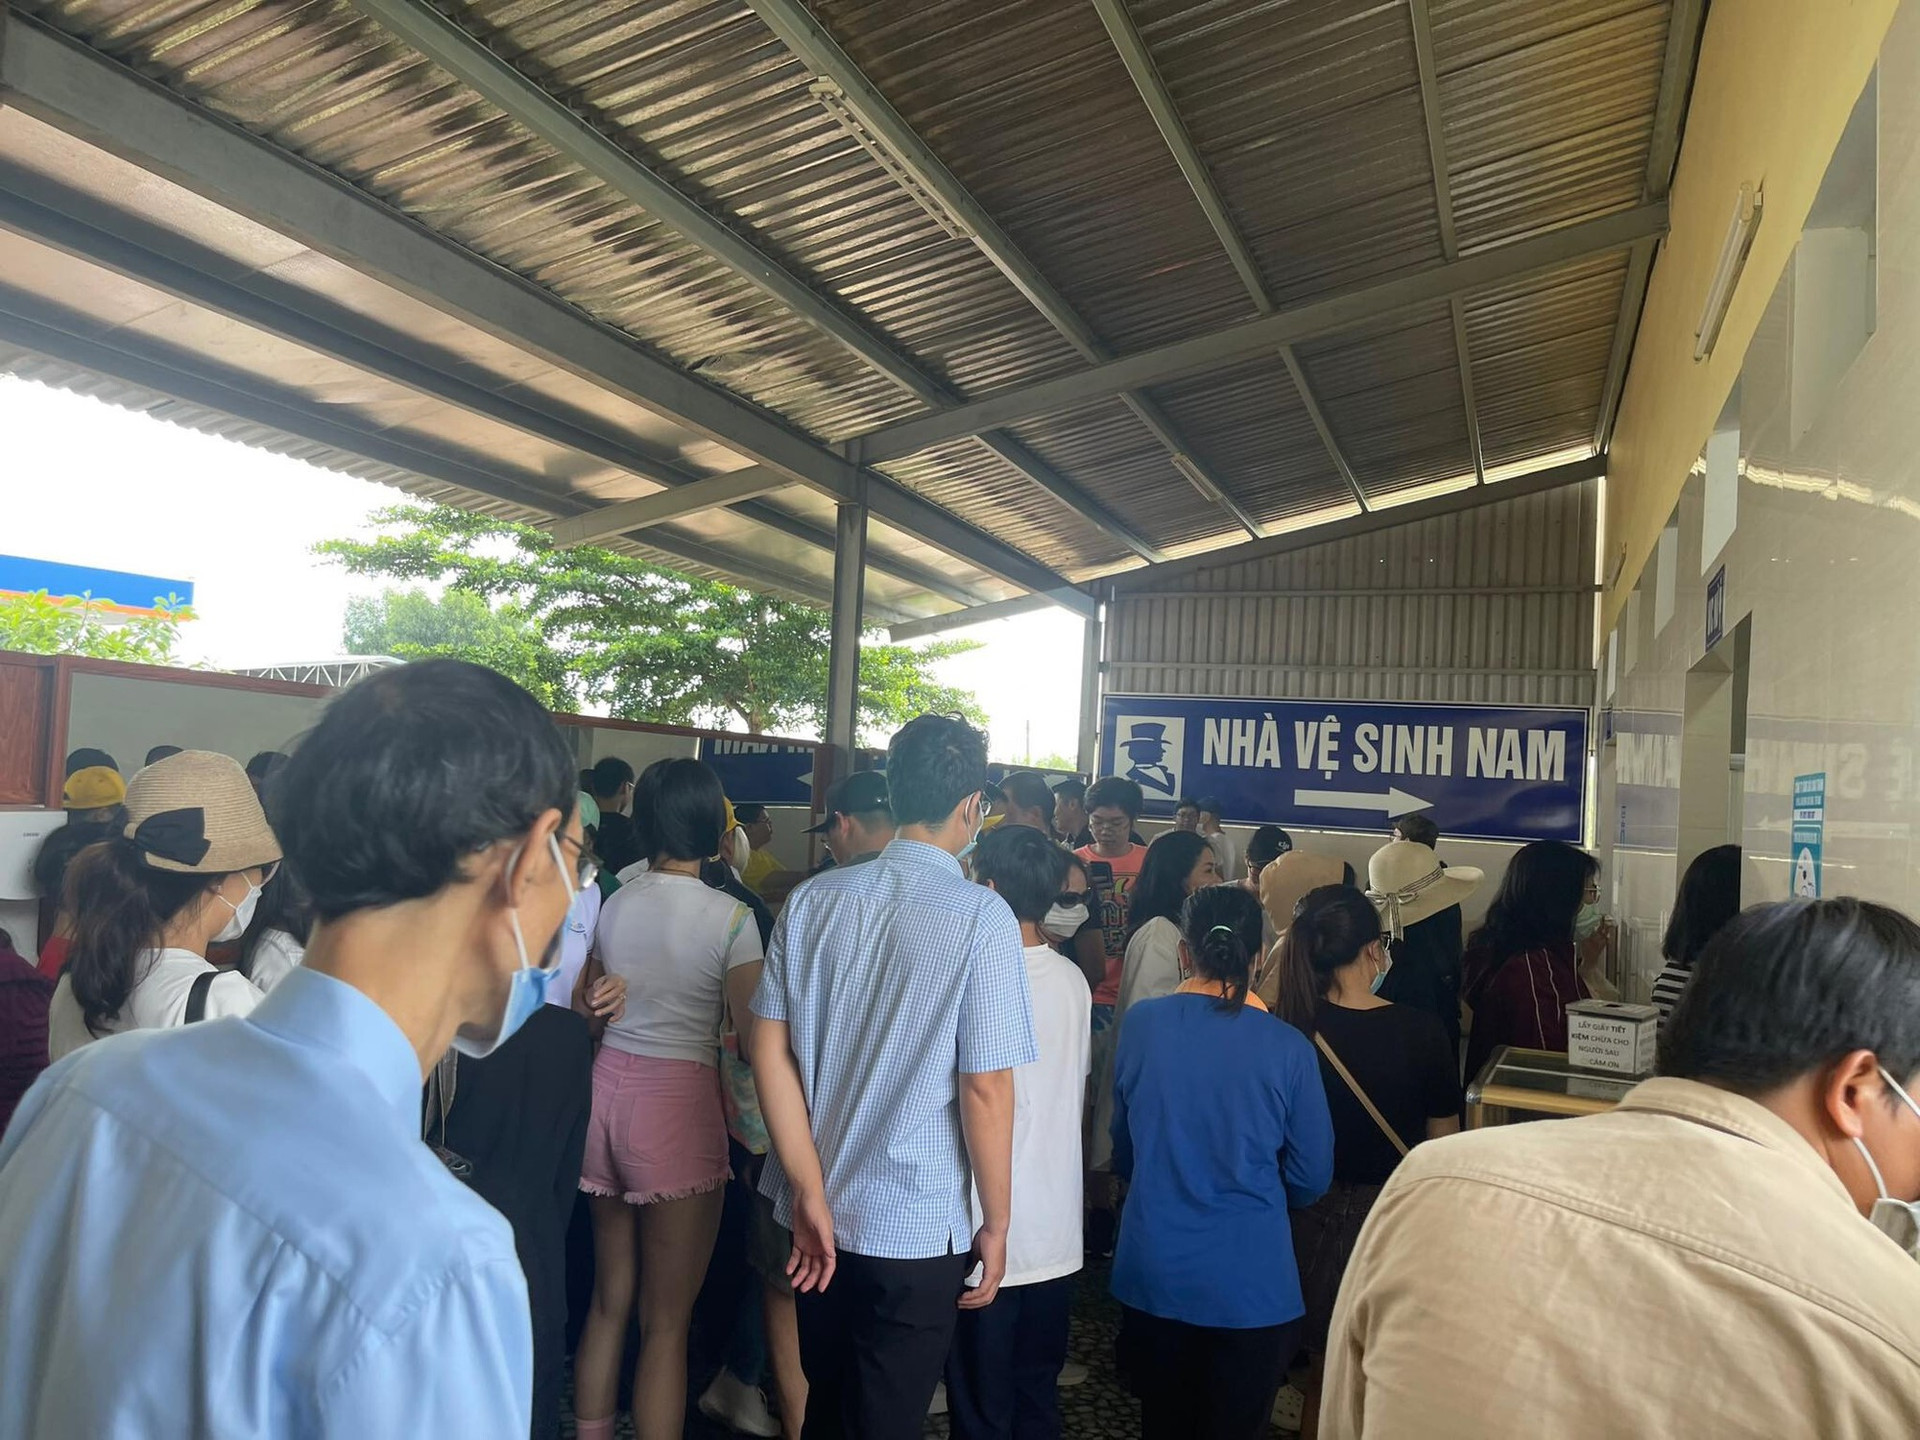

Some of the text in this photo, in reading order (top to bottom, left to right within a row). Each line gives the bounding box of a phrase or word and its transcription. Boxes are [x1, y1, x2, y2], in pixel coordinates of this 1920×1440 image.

[1203, 712, 1281, 768] NHÀ
[1294, 714, 1342, 781] VỆ
[1353, 722, 1452, 777] SINH
[1466, 727, 1566, 782] NAM
[1613, 1038, 1629, 1046] CHO
[1604, 1049, 1620, 1057] SAU
